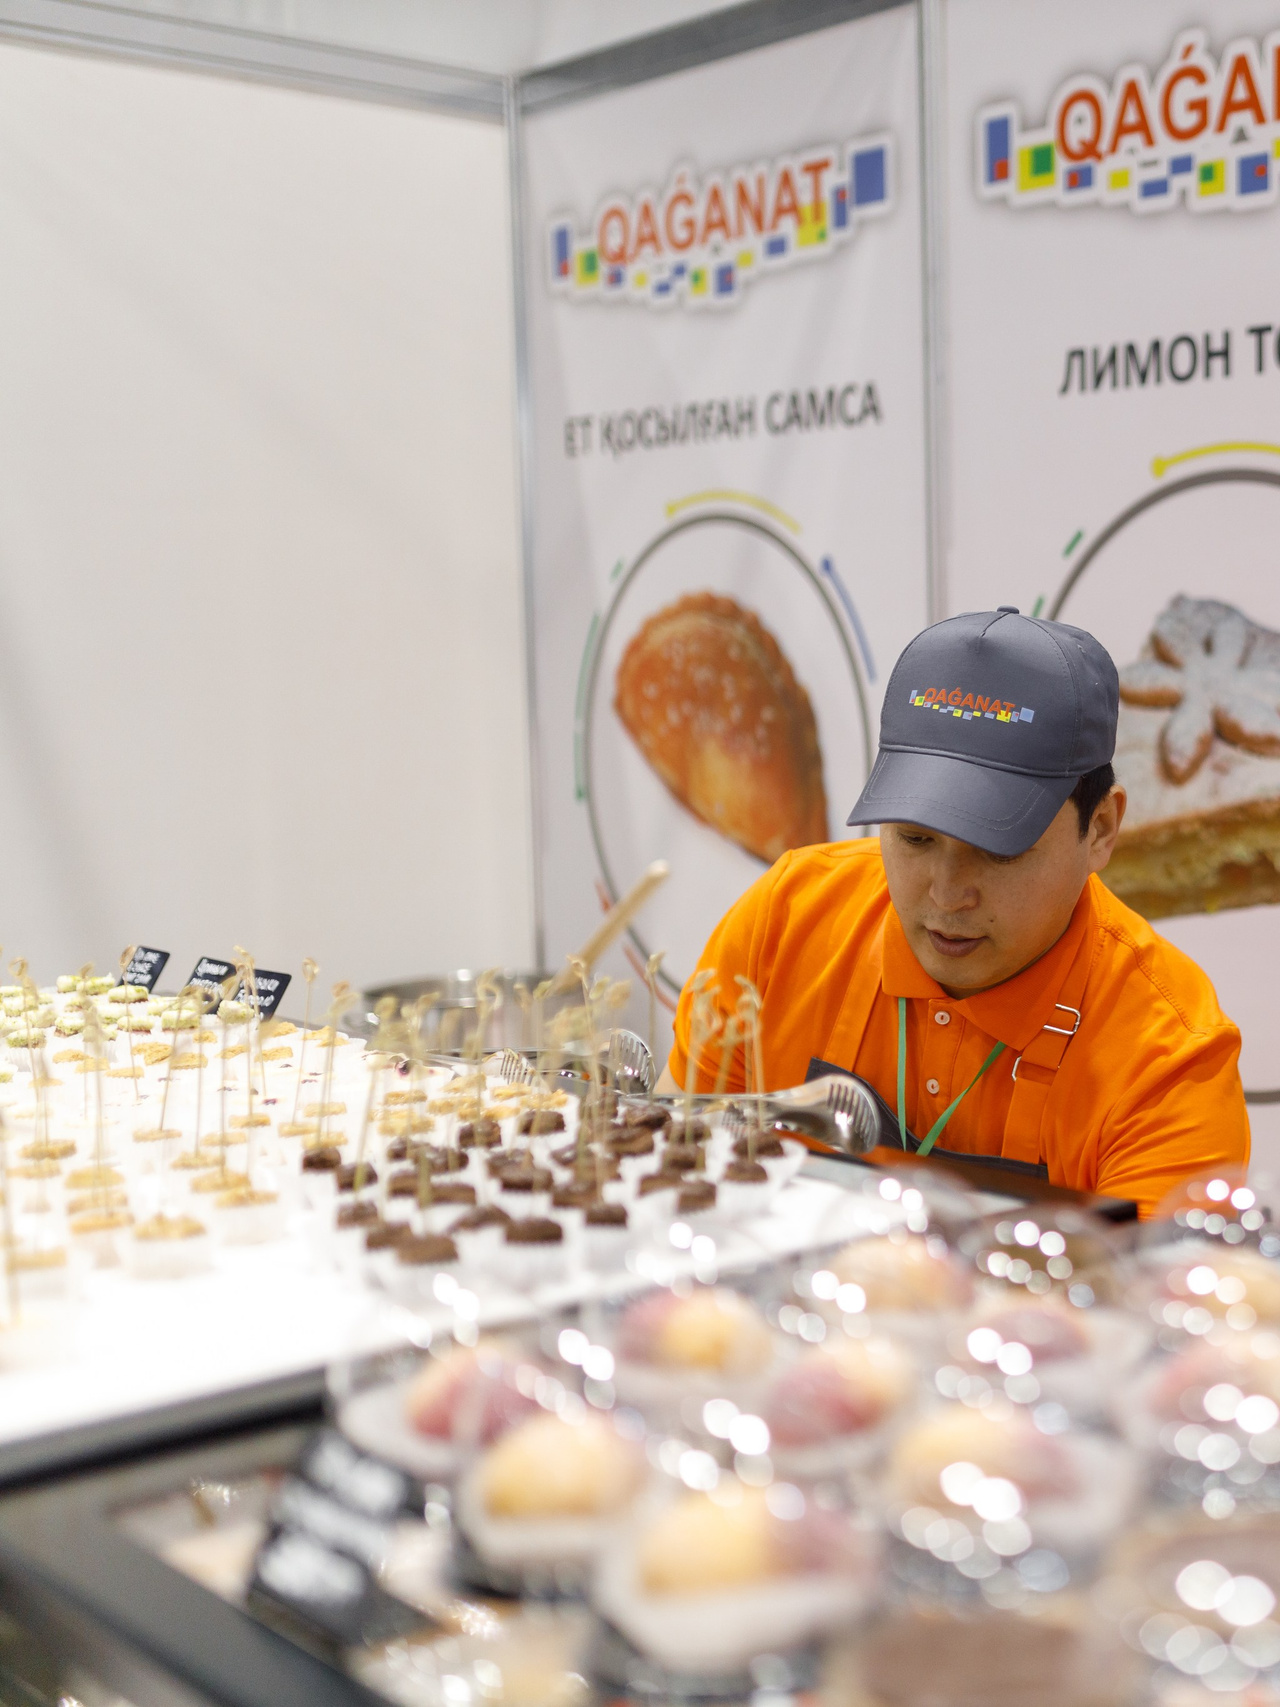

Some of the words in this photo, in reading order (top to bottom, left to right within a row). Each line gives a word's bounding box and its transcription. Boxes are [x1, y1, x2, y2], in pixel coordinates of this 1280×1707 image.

[1058, 329, 1232, 397] ЛИМОН
[563, 414, 594, 459] ЕТ
[764, 380, 884, 437] САМСА
